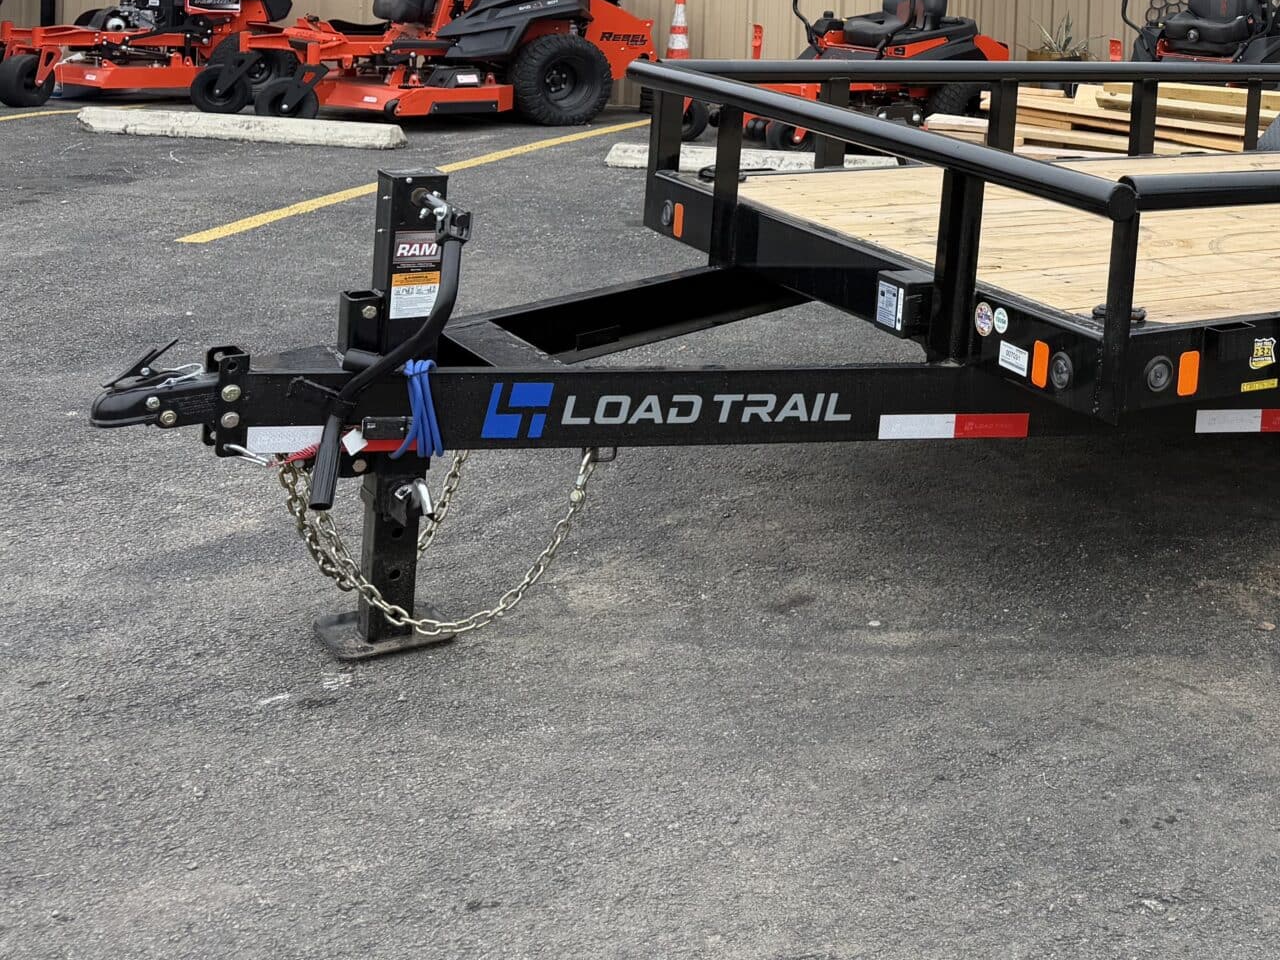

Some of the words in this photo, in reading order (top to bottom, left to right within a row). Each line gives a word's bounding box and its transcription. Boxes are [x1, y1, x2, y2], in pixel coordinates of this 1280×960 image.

[396, 243, 438, 257] RAM
[561, 394, 703, 425] LOAD
[713, 392, 852, 424] TRAIL
